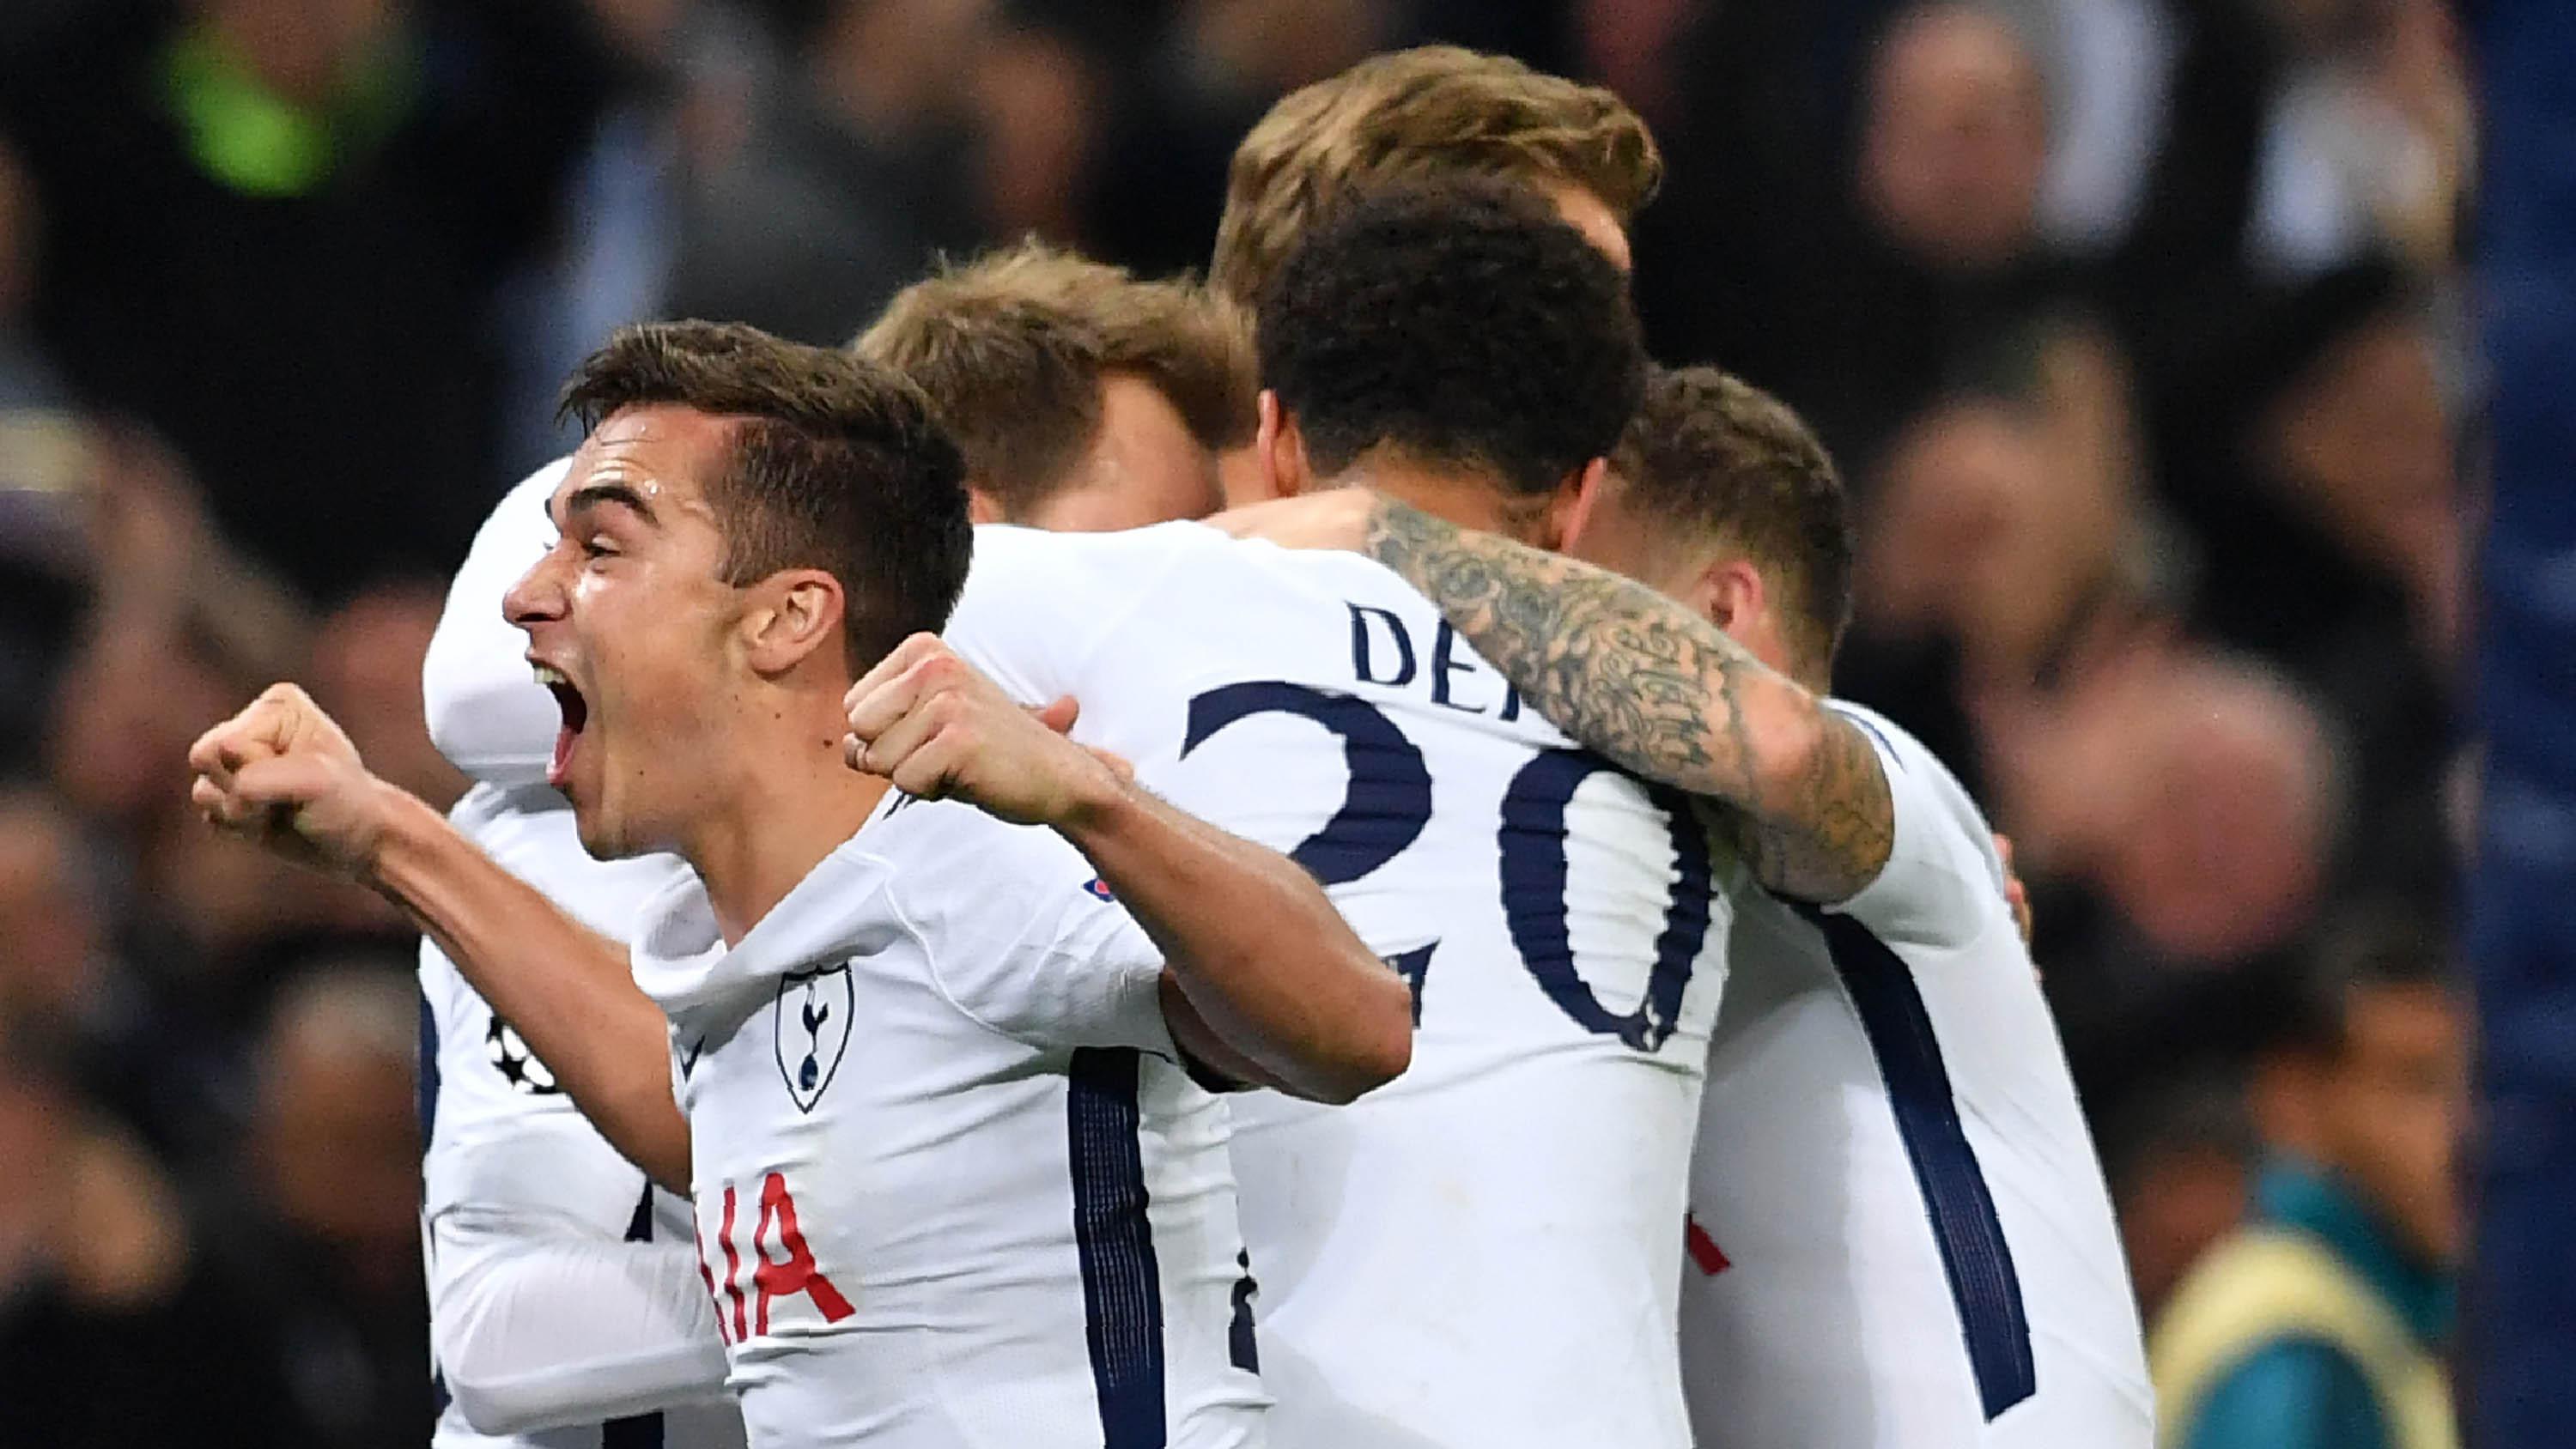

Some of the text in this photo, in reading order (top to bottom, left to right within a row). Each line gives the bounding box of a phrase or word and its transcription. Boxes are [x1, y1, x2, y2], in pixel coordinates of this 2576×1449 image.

[1345, 601, 1520, 722] DE
[1180, 681, 1713, 1052] 20
[693, 1173, 856, 1347] IA
